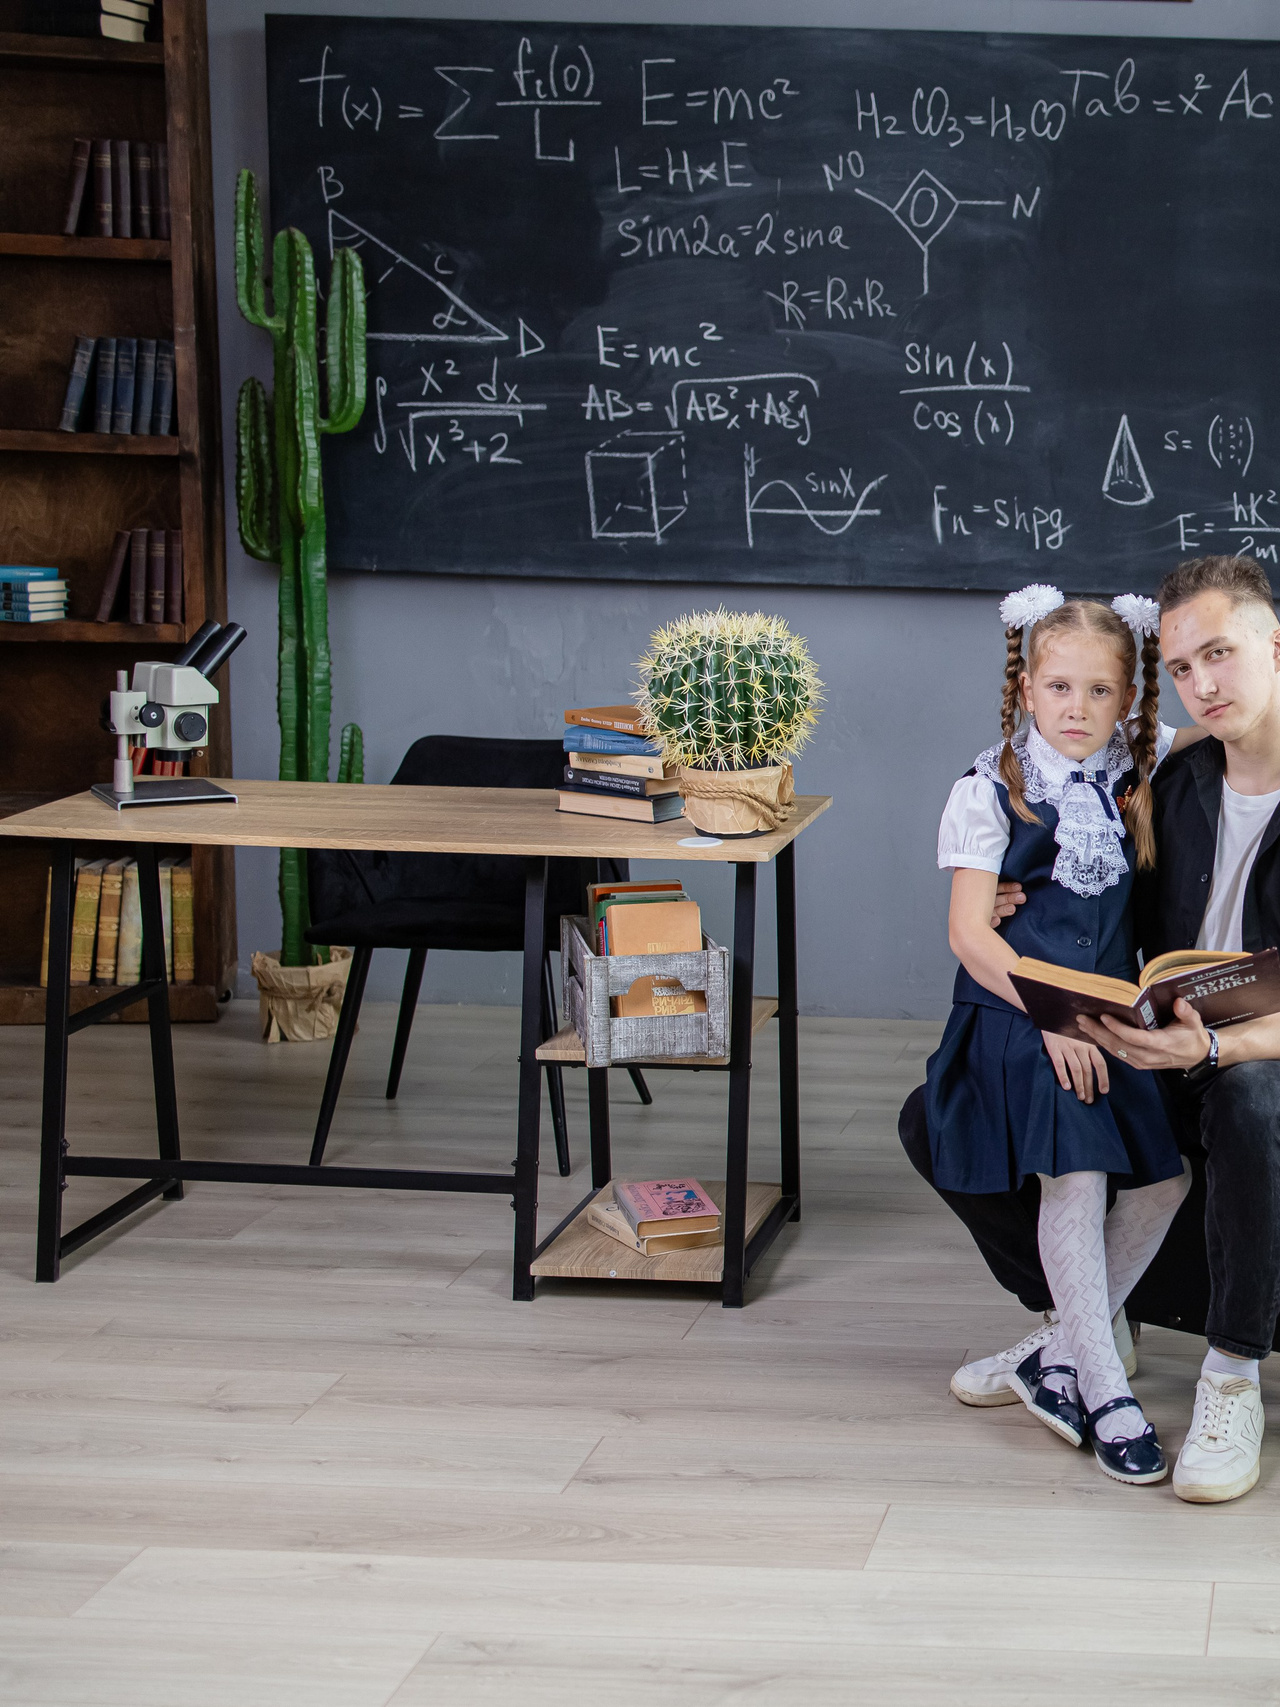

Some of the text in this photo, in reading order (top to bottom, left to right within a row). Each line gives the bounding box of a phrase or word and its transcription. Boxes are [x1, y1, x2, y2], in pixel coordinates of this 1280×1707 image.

[1011, 186, 1041, 218] N
[1182, 975, 1258, 1001] ФИЗИКИ
[1194, 973, 1240, 992] КУРС
